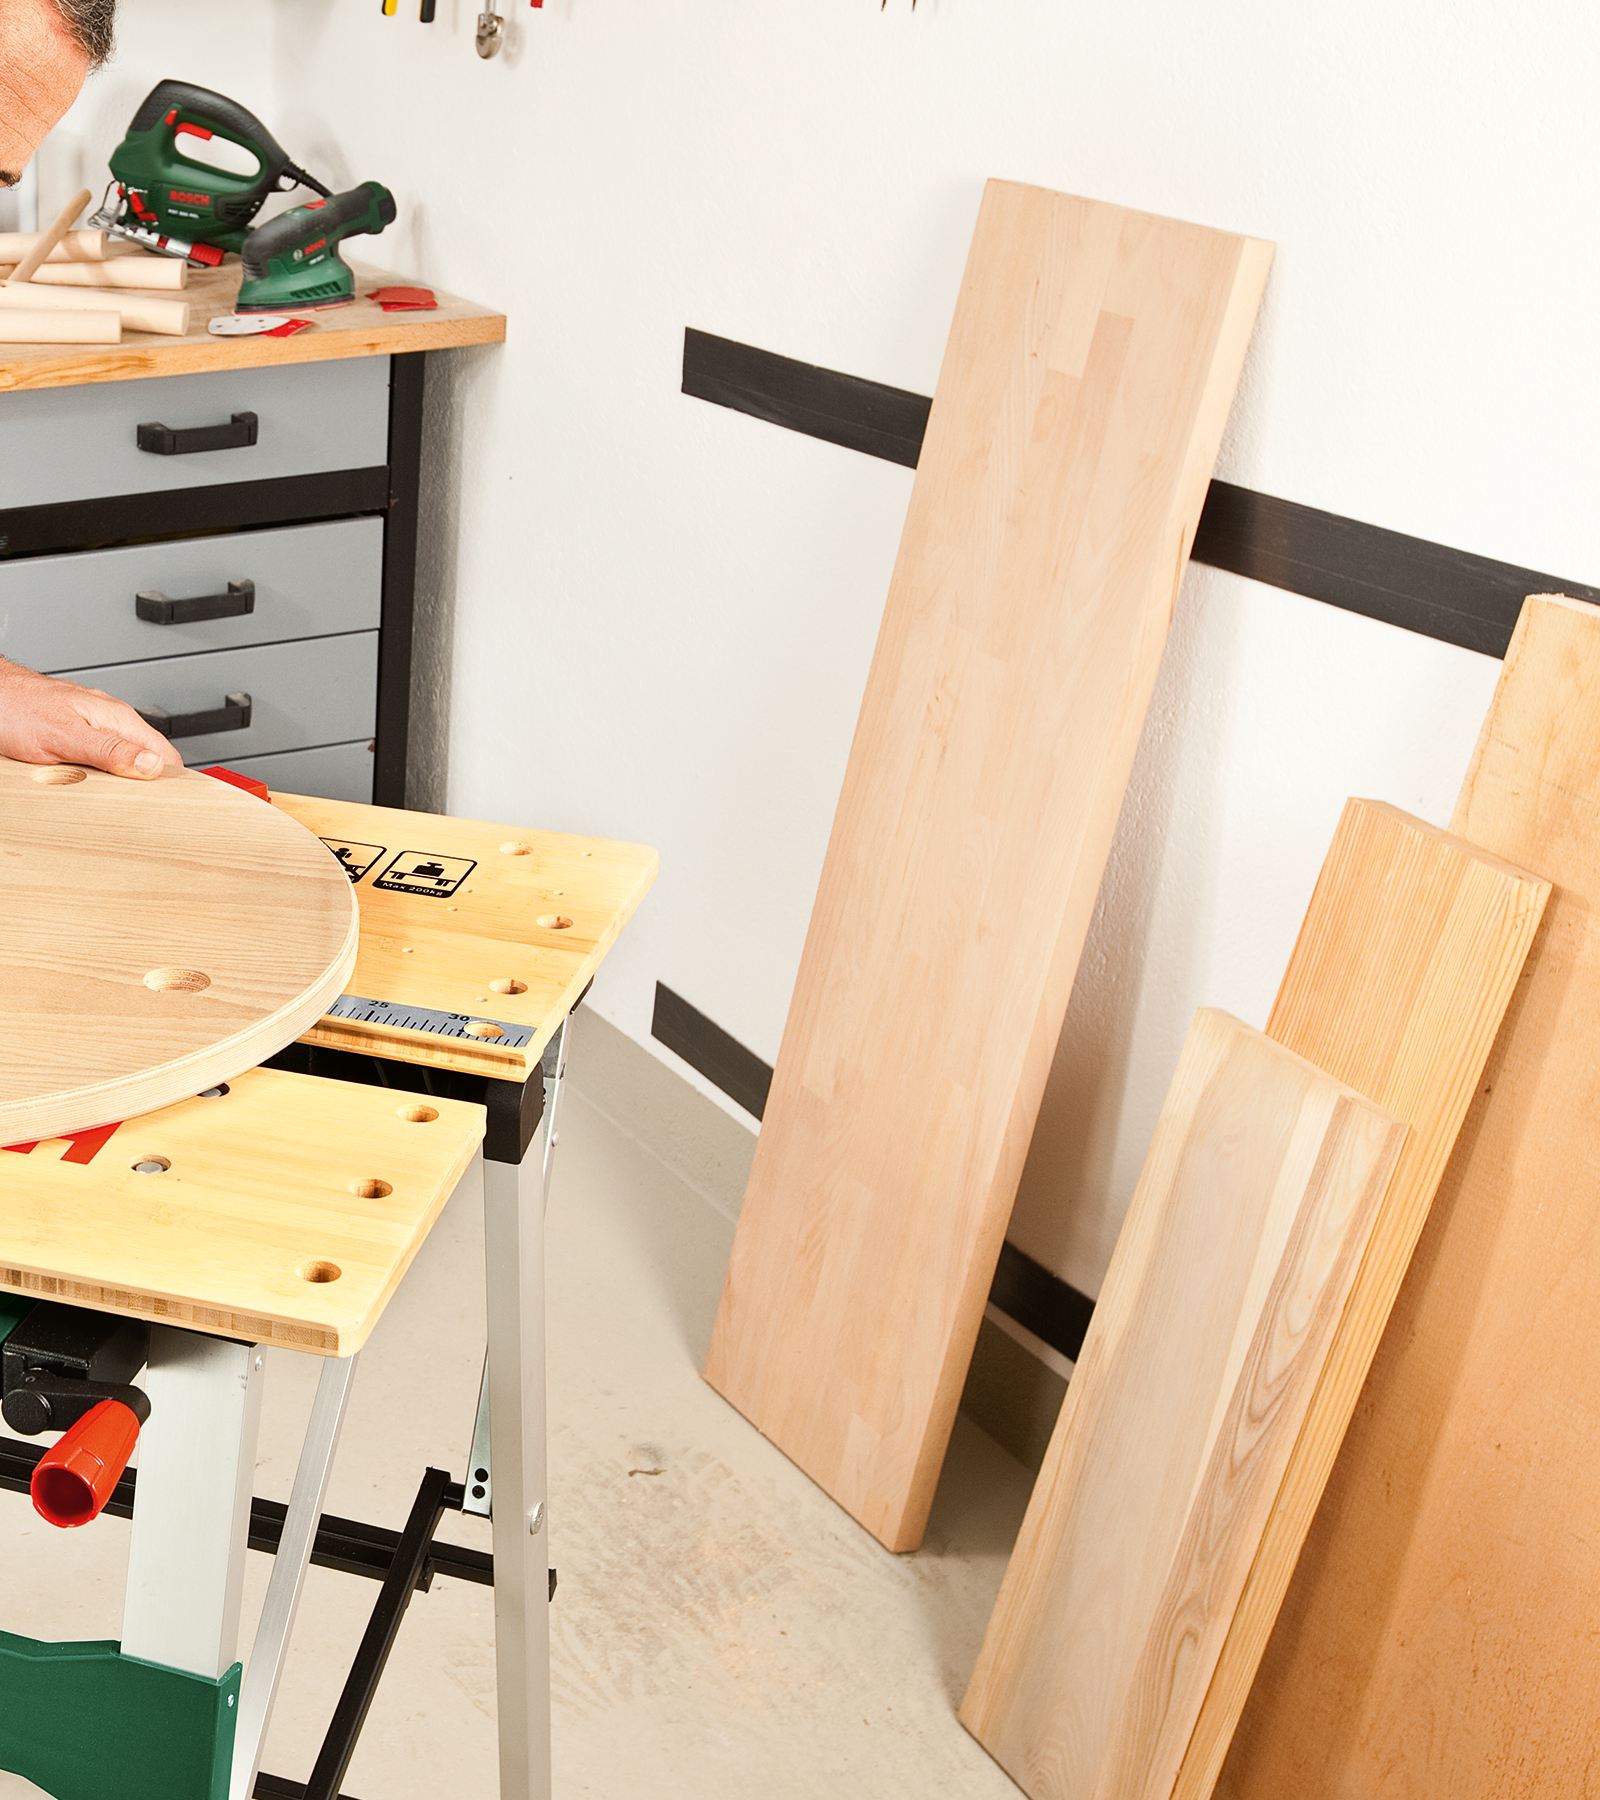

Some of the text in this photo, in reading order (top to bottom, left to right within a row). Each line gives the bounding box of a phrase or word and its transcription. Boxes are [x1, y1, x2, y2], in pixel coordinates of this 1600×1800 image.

[169, 190, 210, 206] BOSCH
[382, 882, 444, 897] Max 200kg
[368, 1000, 471, 1022] 25 30
